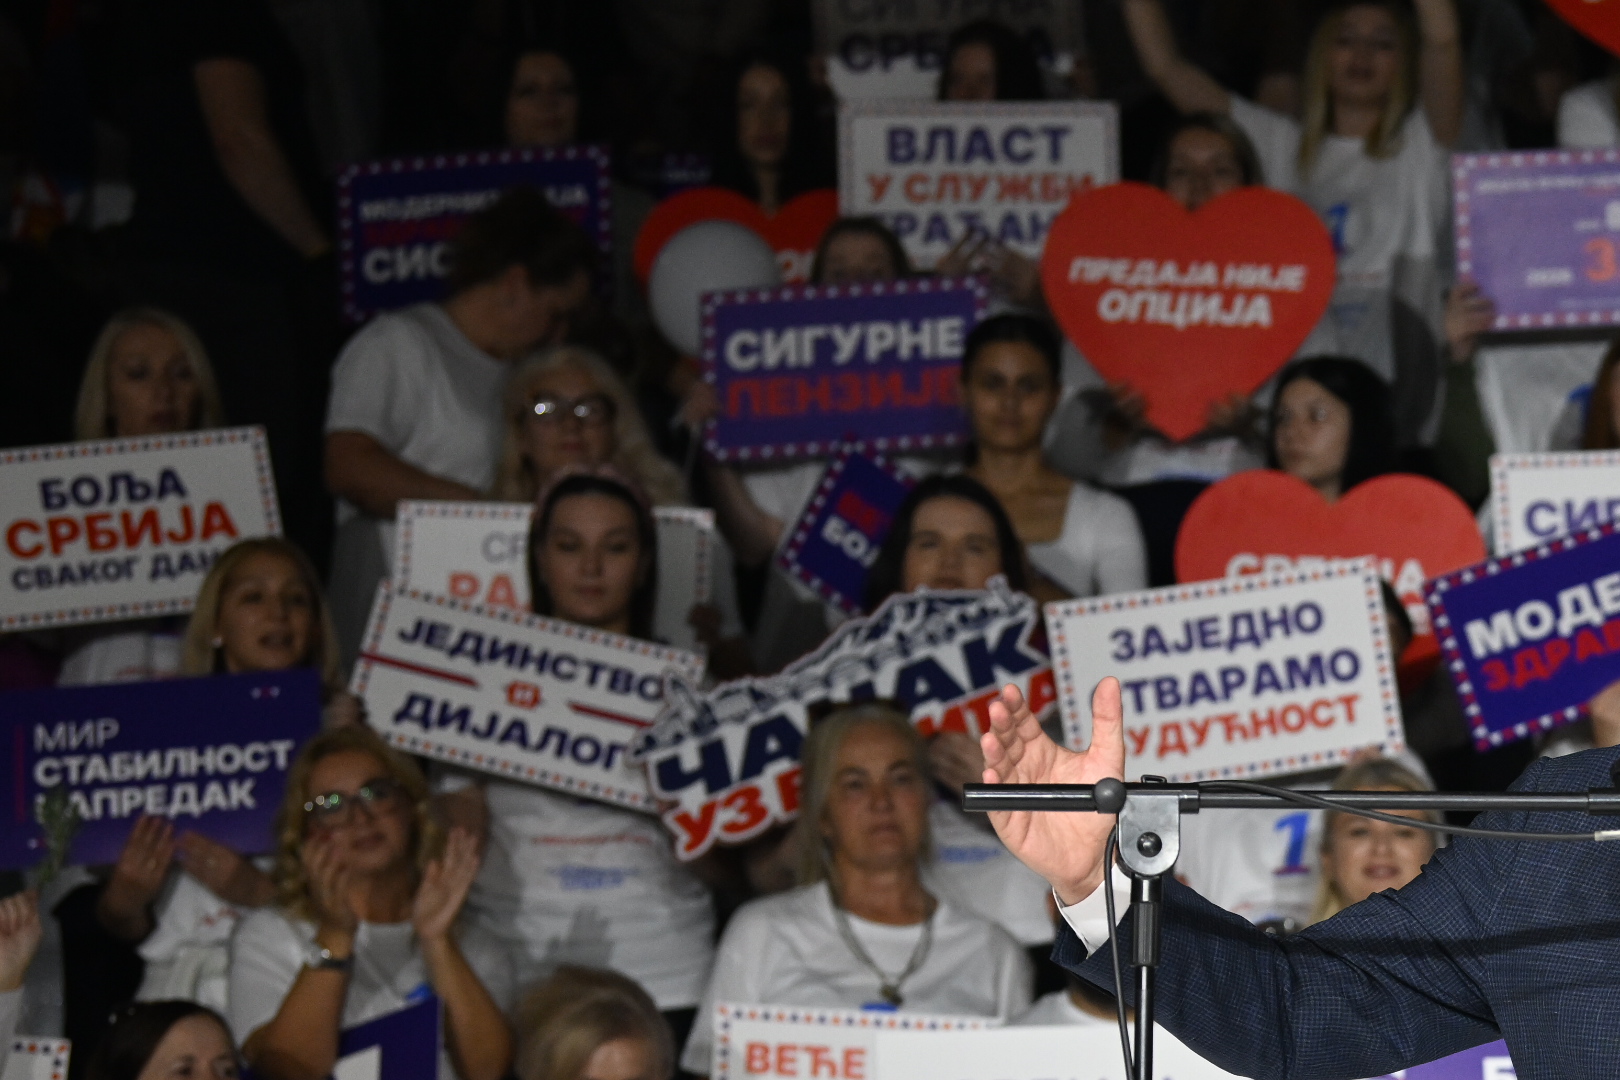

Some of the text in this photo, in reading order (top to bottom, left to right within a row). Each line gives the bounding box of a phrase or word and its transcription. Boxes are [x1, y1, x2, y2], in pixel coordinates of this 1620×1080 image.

[888, 126, 1072, 164] ВЛАСТ
[866, 174, 892, 202] У
[1068, 256, 1308, 293] ПРЕДАЈА НИЈЕ
[1097, 290, 1273, 332] ОПЦИЈА
[724, 315, 967, 374] СИГУРНЕ
[40, 468, 187, 511] БОЉА
[6, 502, 238, 559] СРБИЈА
[12, 549, 226, 592] СВАКОГ ДАН
[1111, 602, 1323, 662] ЗАЈЕДНО
[398, 616, 665, 702] ЈЕДИНСТВО
[1122, 650, 1361, 714] ТВАРАМО
[394, 692, 632, 770] ДИЈАЛОГ
[656, 622, 1040, 794] ЧААК
[1124, 694, 1361, 759] УДУЋНОСТ
[33, 717, 120, 753] МИР
[33, 739, 294, 789] СТАБИЛНОСТ
[745, 1041, 866, 1080] ВЕЋЕ
